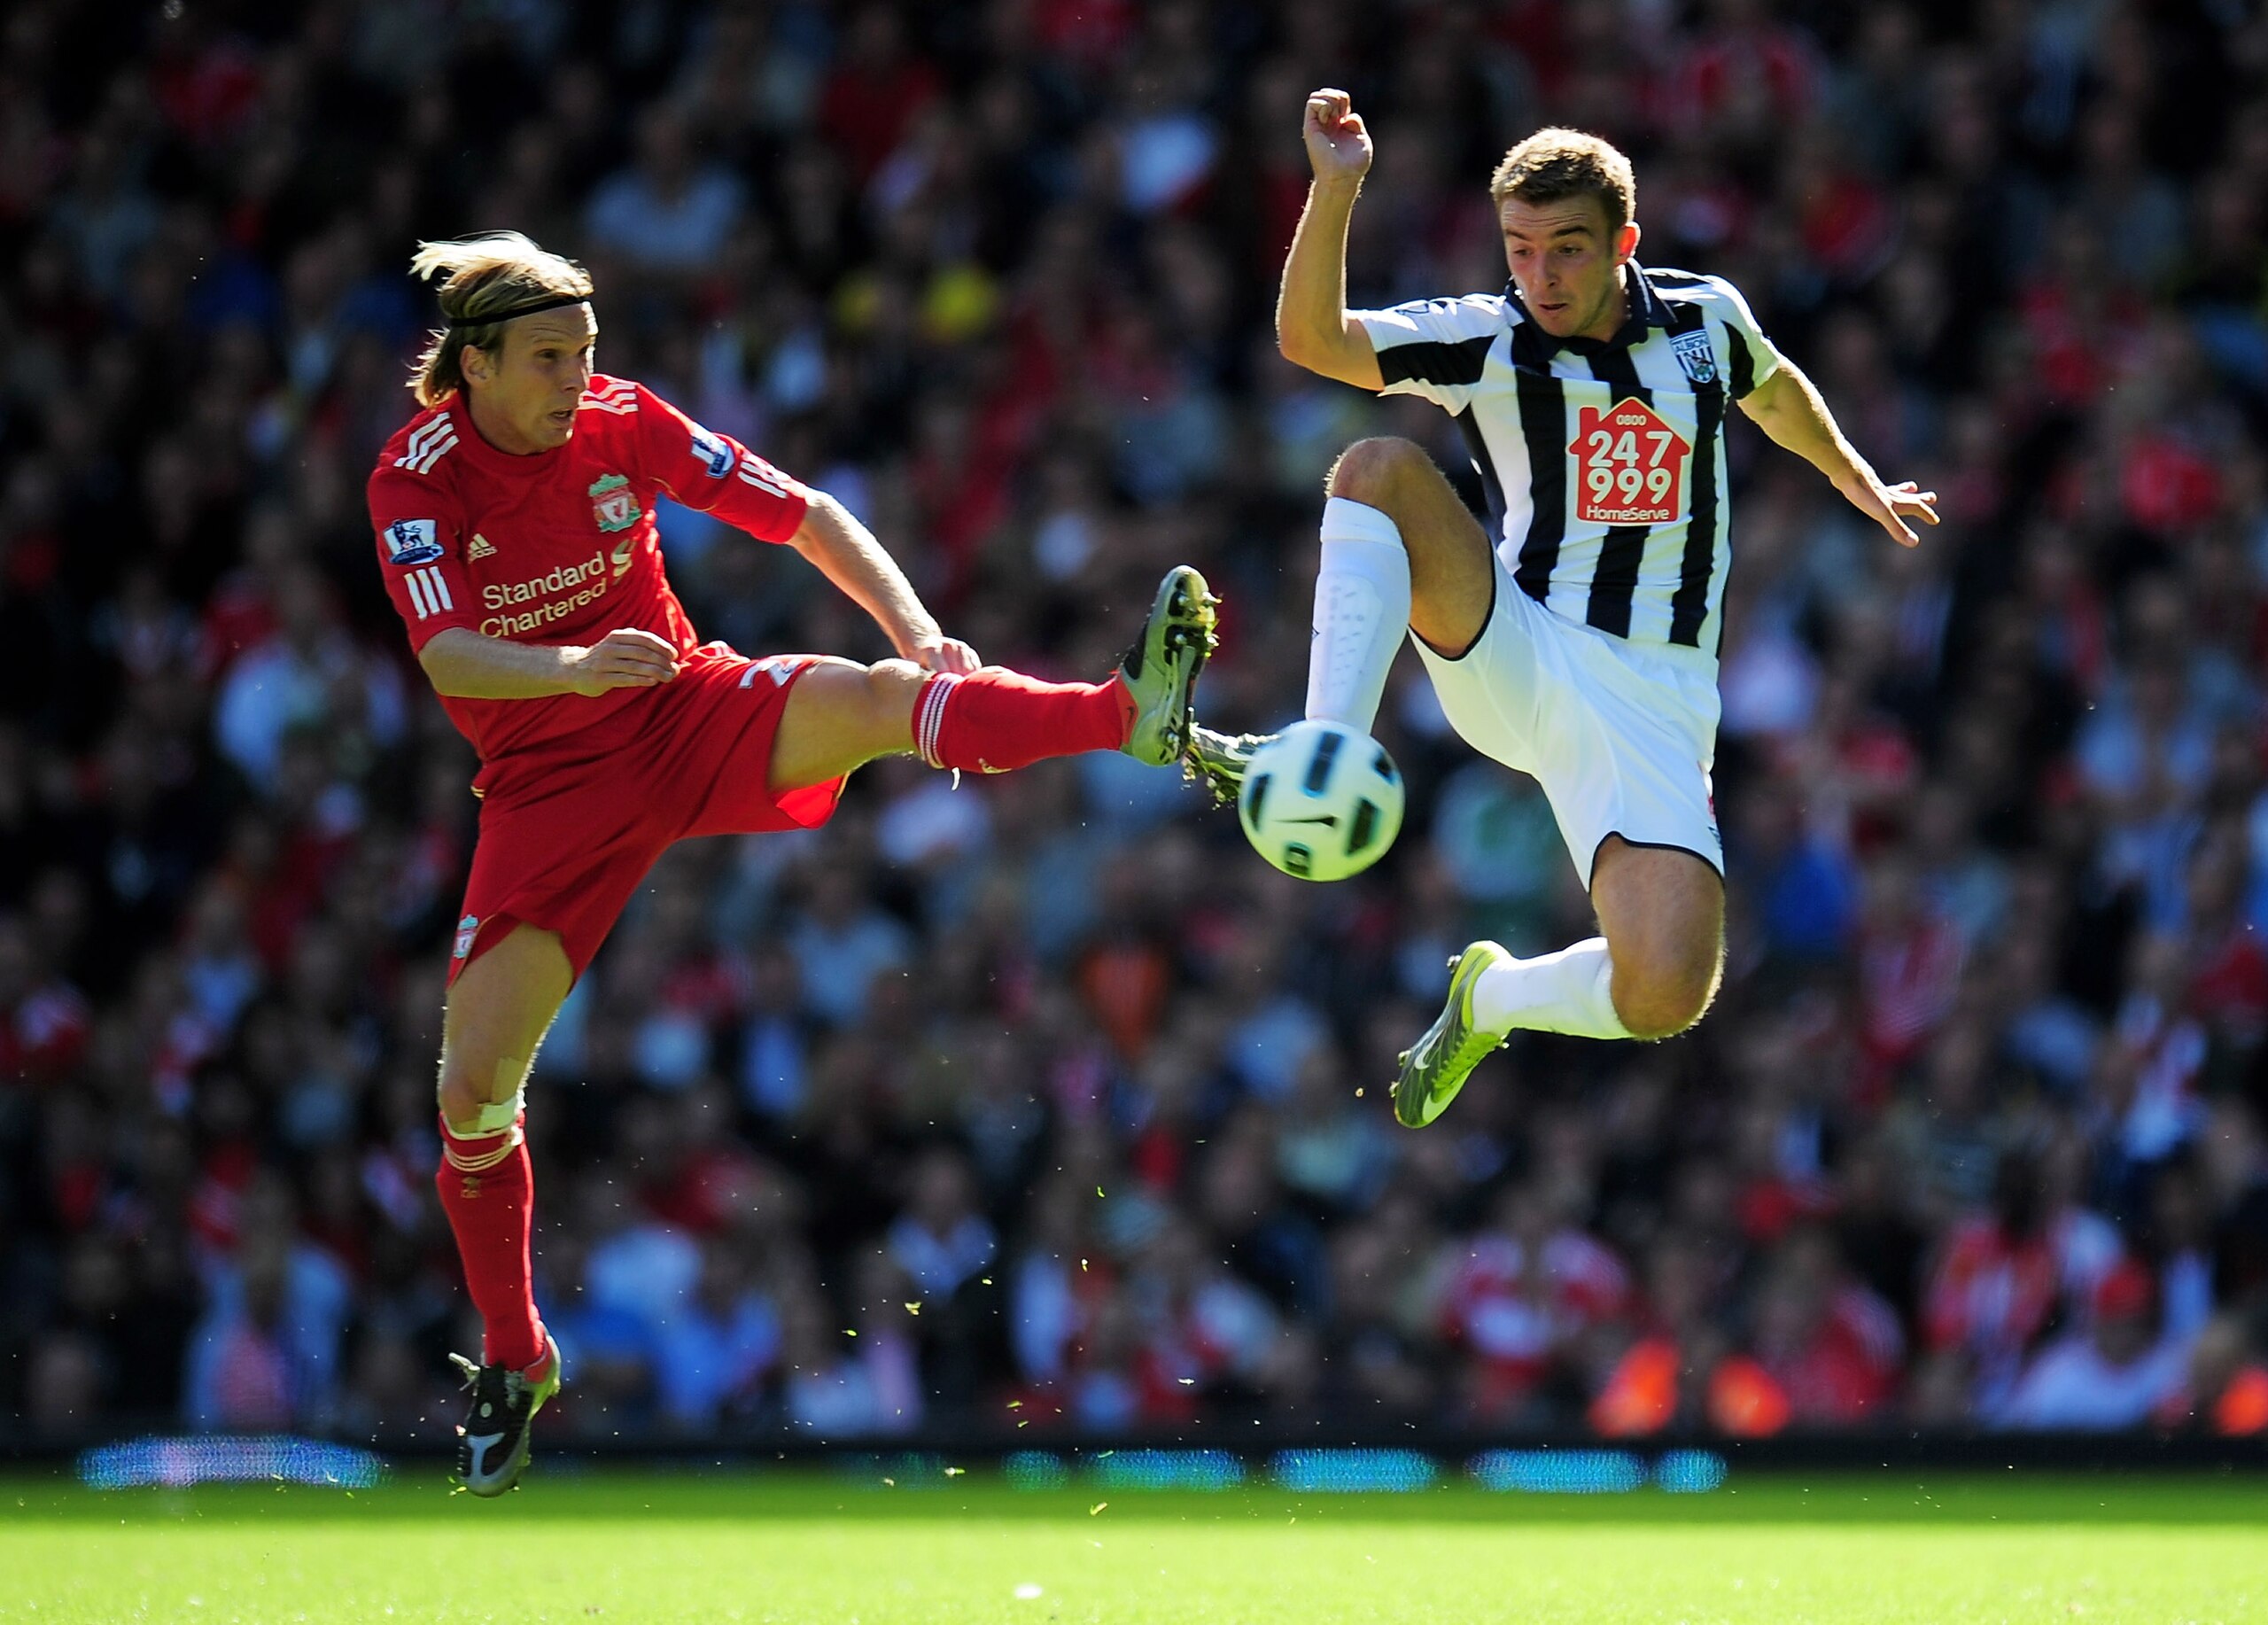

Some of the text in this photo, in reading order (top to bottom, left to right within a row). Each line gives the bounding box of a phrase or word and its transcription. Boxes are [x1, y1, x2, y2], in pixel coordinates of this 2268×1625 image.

[1588, 431, 1674, 468] 247
[1587, 467, 1673, 505] 999
[1586, 505, 1670, 520] HomeServe
[482, 551, 605, 610] Standard
[479, 578, 606, 638] Chartered
